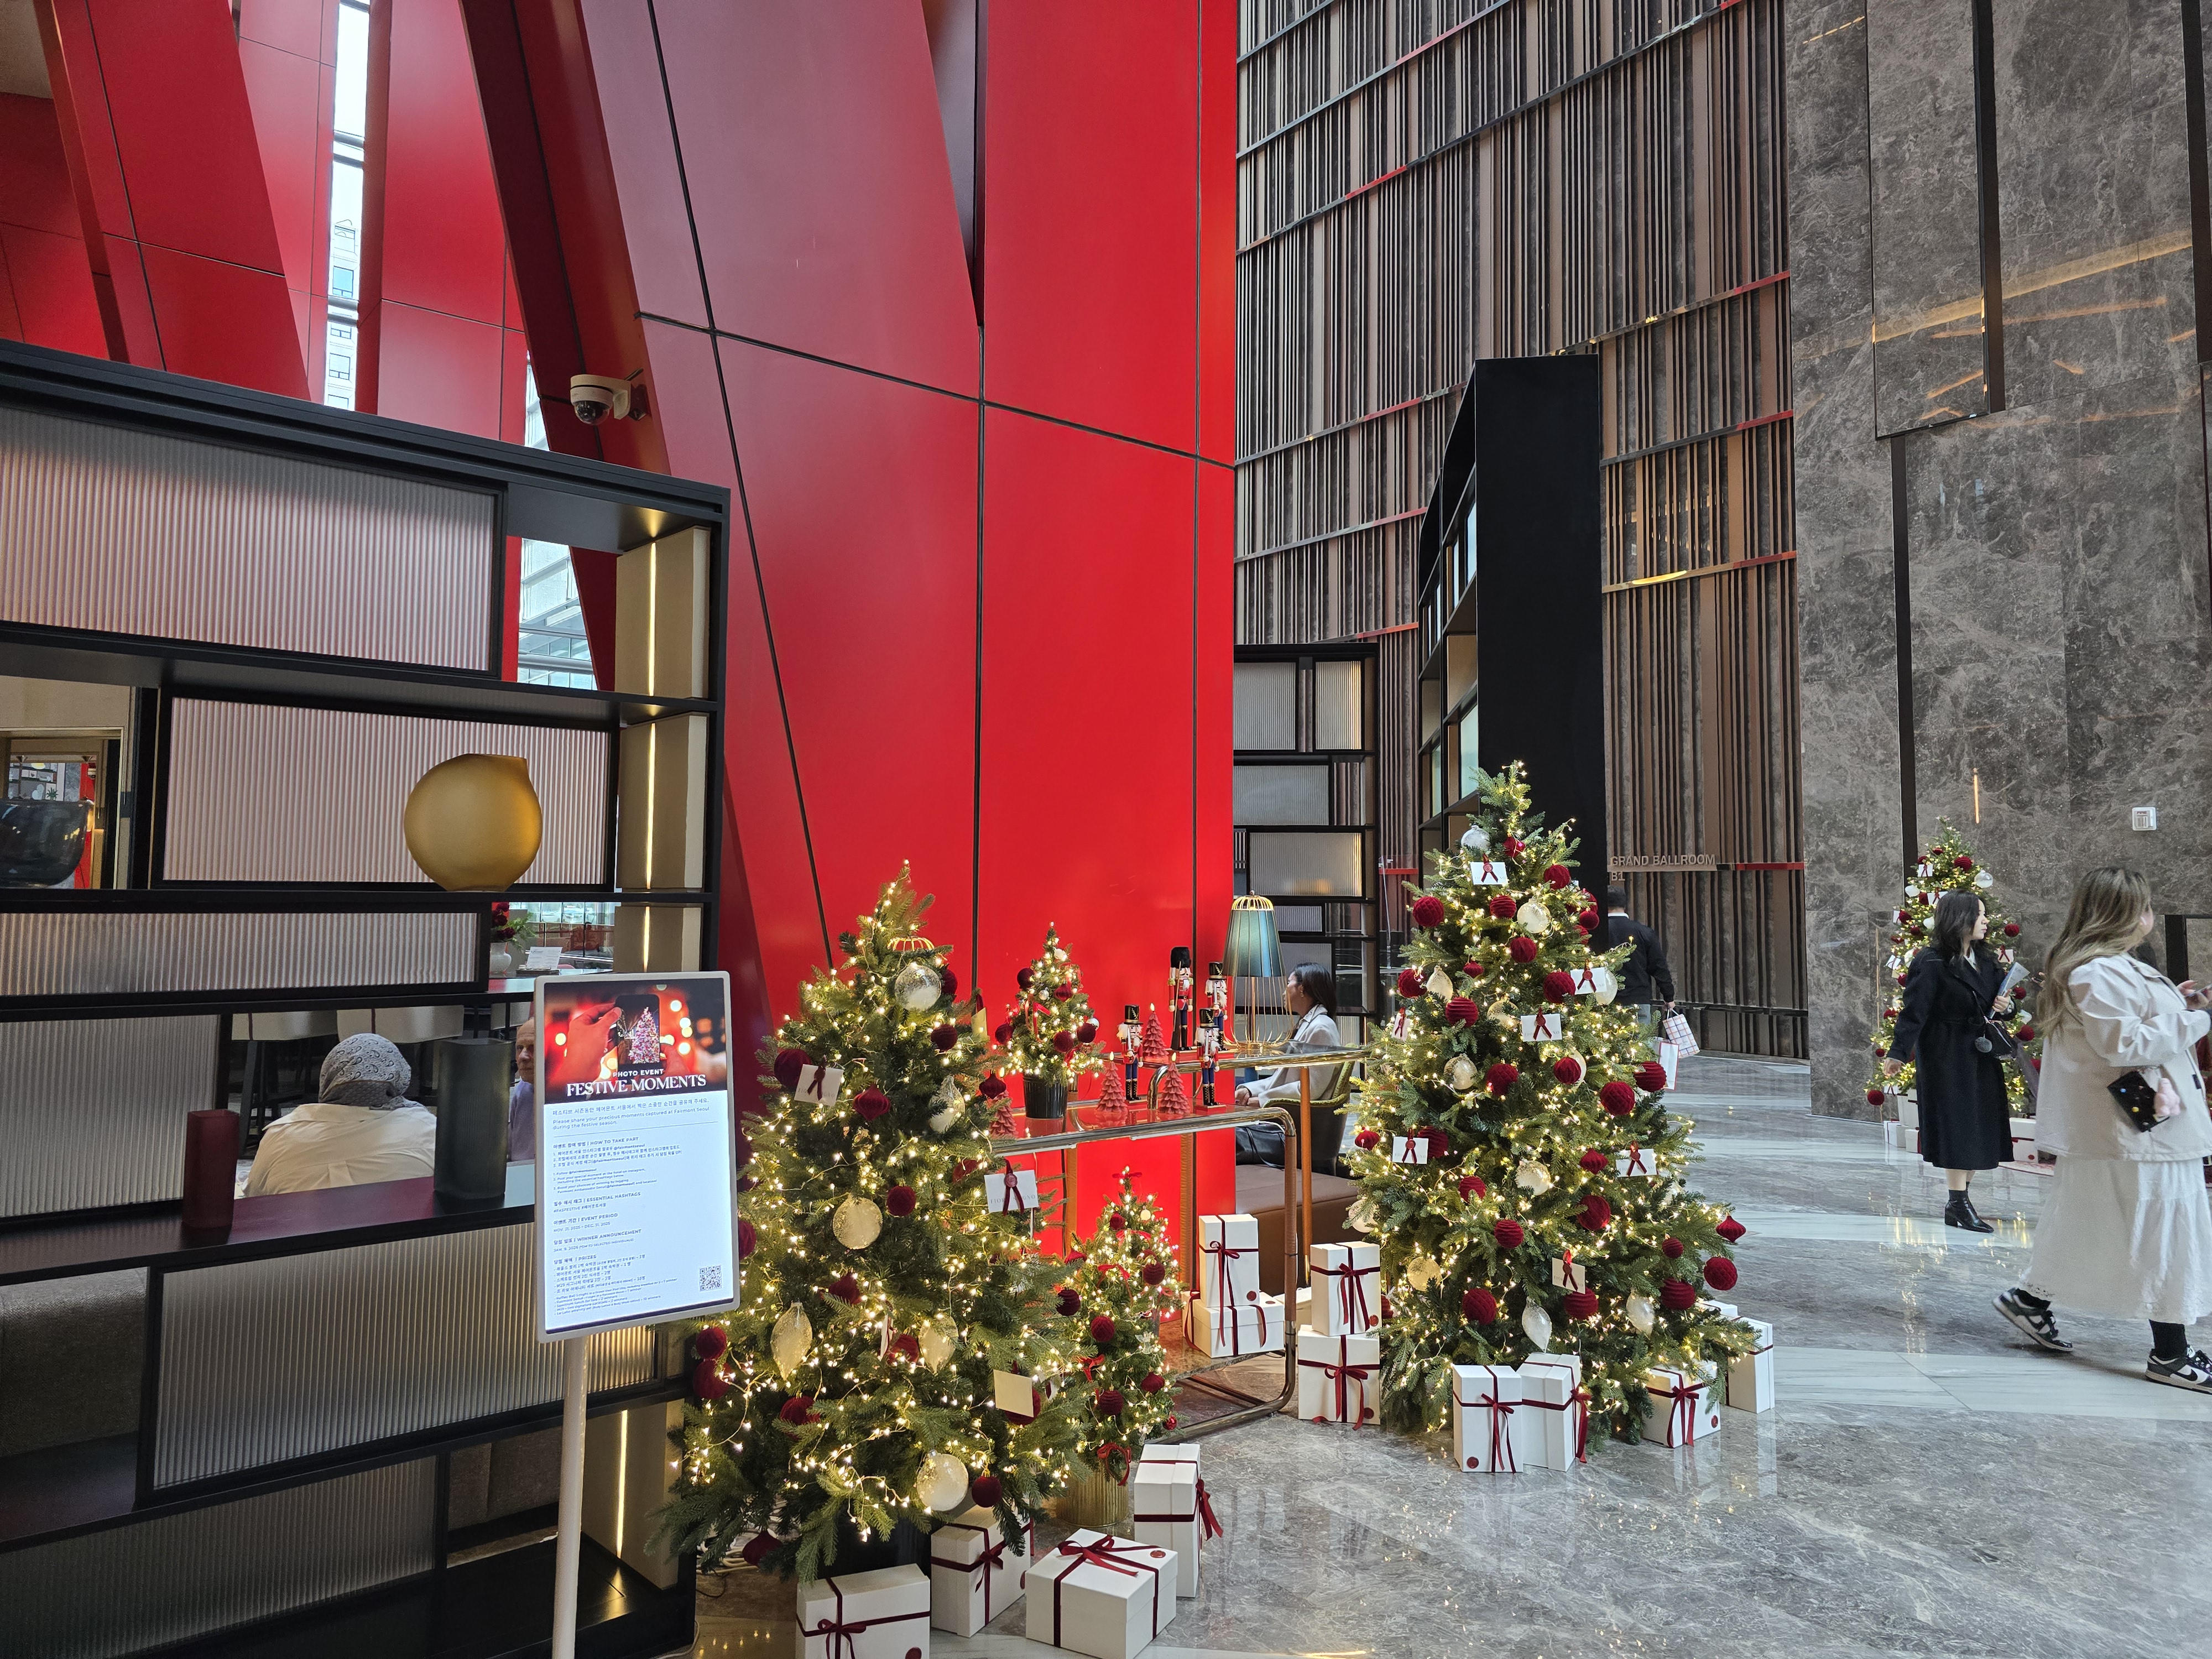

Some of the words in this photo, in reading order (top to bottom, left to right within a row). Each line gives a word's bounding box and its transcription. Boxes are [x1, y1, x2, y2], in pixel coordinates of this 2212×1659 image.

[1610, 855, 1649, 866] GRAND
[1653, 854, 1715, 865] BALLROOM
[1611, 871, 1625, 881] B1
[567, 1079, 628, 1096] FESTIVE
[630, 1074, 706, 1092] MOMENTS
[599, 1229, 641, 1239] ANNOUNCEMENT
